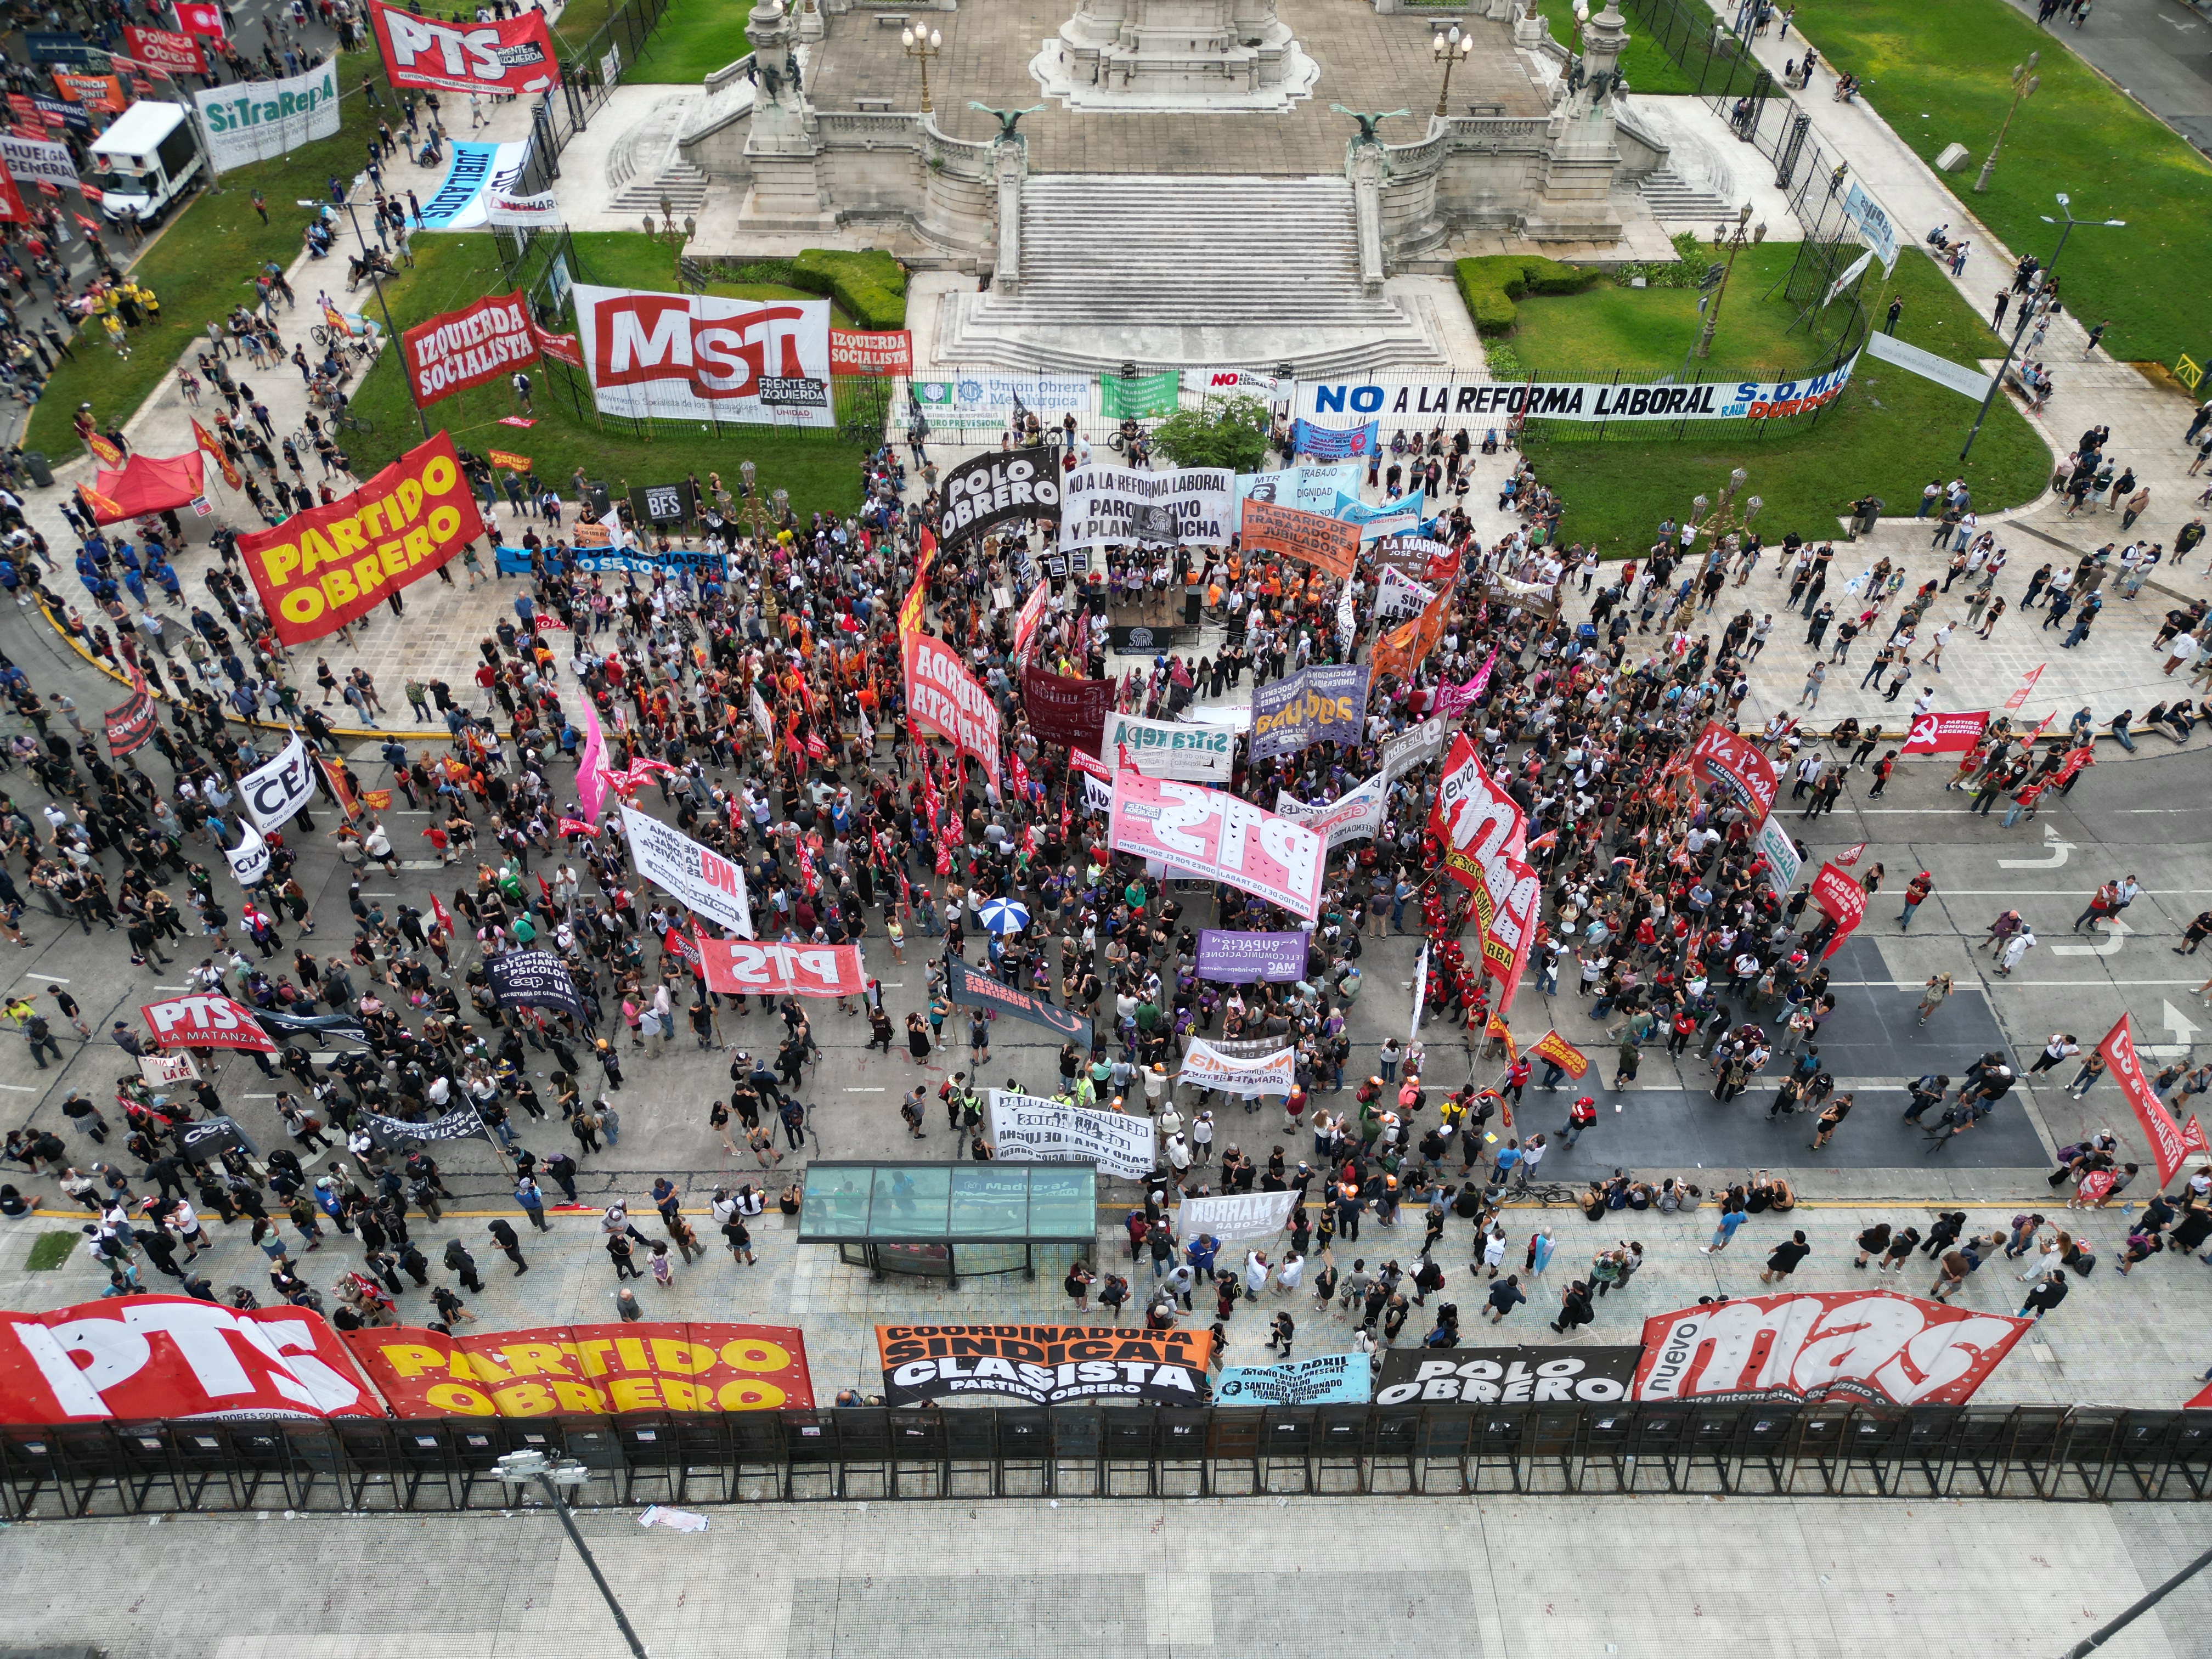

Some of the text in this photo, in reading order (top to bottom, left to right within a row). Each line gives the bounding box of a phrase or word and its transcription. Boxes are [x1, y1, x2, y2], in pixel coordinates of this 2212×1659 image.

[382, 8, 508, 80] PTS
[498, 45, 529, 57] FRENTE
[500, 52, 544, 64] IZQUIERDA
[2, 142, 68, 162] HUELGA
[4, 157, 78, 180] GENERAL
[421, 149, 490, 220] JUBILADOS
[415, 303, 524, 367] IZQUIERDA
[831, 331, 907, 351] IZQUIERDA
[611, 308, 804, 391] MST
[832, 348, 909, 365] SOCIALISTA
[420, 330, 534, 397] SOCIALISTA
[759, 378, 820, 390] FRENTE DE
[989, 379, 1087, 393] Unión Obrera
[1121, 384, 1166, 395] TRABAJADORES
[1137, 376, 1166, 387] NACIONAL
[1211, 373, 1238, 386] NO
[1239, 381, 1268, 389] LABORAL
[597, 391, 758, 413] Movimiento Socialista de los Trabajadores
[760, 388, 825, 400] IZQUIERDA
[1316, 386, 1714, 415] NO A LA REFORMA LABORAL
[1722, 382, 1842, 419] RAUL DURDOS
[777, 409, 810, 417] UNIDAD
[950, 460, 1034, 506] POLO
[1255, 475, 1280, 484] MTR
[1301, 467, 1338, 478] TRABAJO
[1069, 471, 1227, 498] NO A LA REFORMA LABORAL
[1297, 487, 1333, 498] DIGNIDAD
[648, 495, 681, 517] BFS
[942, 480, 1060, 539] OBRERO
[1090, 499, 1133, 517] PARO
[260, 455, 457, 587] PARTIDO
[1071, 522, 1080, 541] Y
[1087, 520, 1132, 538] PLAN
[1257, 505, 1348, 537] PLENARIO DE
[1247, 514, 1354, 551] TRABAJADORES
[1263, 526, 1338, 556] JUBILADOS
[1383, 540, 1399, 550] LA
[1389, 549, 1412, 557] JOSÉ
[280, 506, 461, 624] OBRERO
[601, 558, 624, 571] SE
[1385, 604, 1400, 616] LA
[1128, 635, 1153, 647] SUTNA
[1707, 759, 1716, 768] LA
[1714, 763, 1752, 803] IZQUIERDA
[262, 814, 284, 830] Centro
[509, 976, 544, 989] cep
[500, 990, 533, 999] SECRETARÍA
[150, 997, 238, 1032] PTS
[161, 1031, 257, 1044] LA MATANZA
[1539, 1042, 1582, 1074] OBRERO
[163, 1068, 177, 1081] LA
[888, 1325, 1194, 1345] COORDINADORA
[12, 1303, 360, 1417] PTS
[379, 1338, 792, 1379] PARTIDO
[885, 1337, 1198, 1368] SINDICAL
[1649, 1323, 1700, 1392] nuevo
[1694, 1297, 2017, 1405] mas
[893, 1356, 1197, 1393] CLASISTA
[1241, 1368, 1278, 1378] ANTONIO
[1304, 1366, 1345, 1378] PRESENTE
[1415, 1358, 1588, 1382] POLO
[951, 1378, 1142, 1403] PARTIDO OBRERO
[1244, 1379, 1342, 1393] SANTIAGO MALDONADO
[1293, 1387, 1331, 1397] DIGNIDAD
[1376, 1378, 1626, 1406] OBRERO
[426, 1376, 787, 1418] OBRERO
